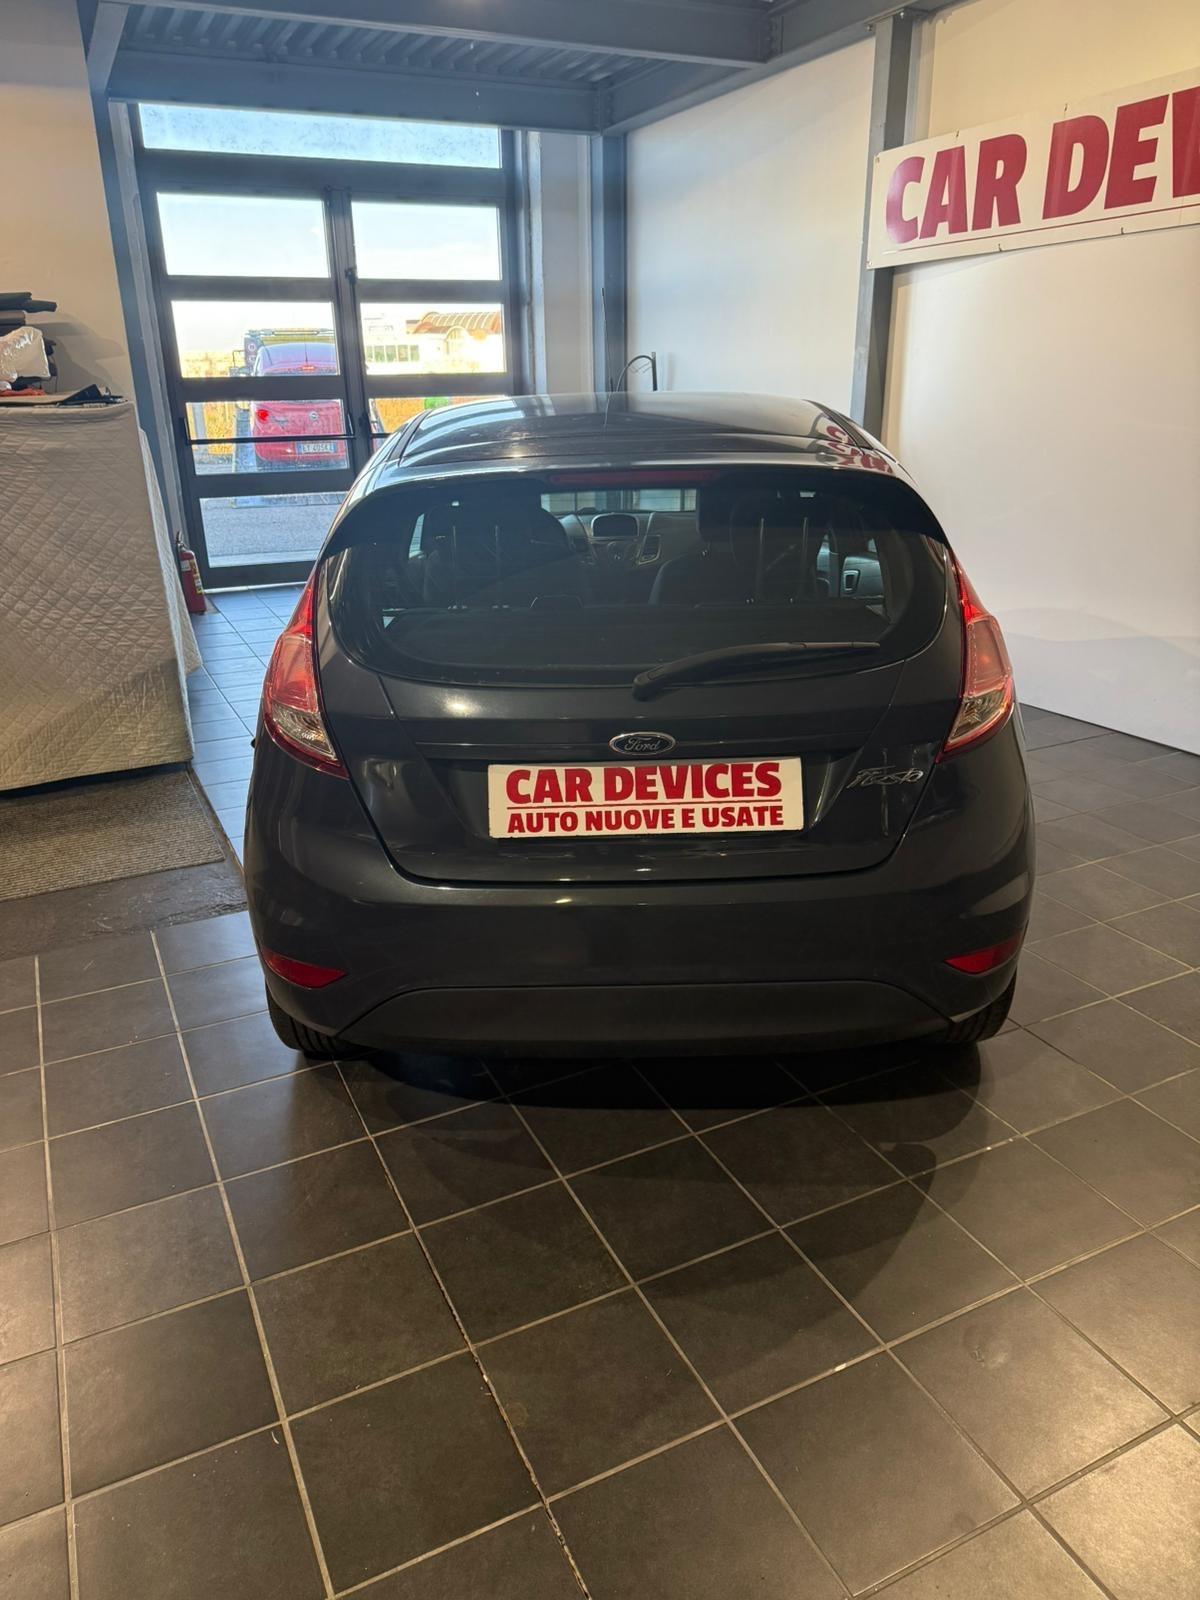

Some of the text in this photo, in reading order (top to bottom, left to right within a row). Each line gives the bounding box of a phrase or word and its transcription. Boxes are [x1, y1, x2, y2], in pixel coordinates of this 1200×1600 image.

[885, 133, 1028, 244] CAR
[624, 736, 661, 751] Ford
[506, 762, 782, 804] CAR DEVICES
[507, 805, 784, 834] AUTO NUOVE E USATE
